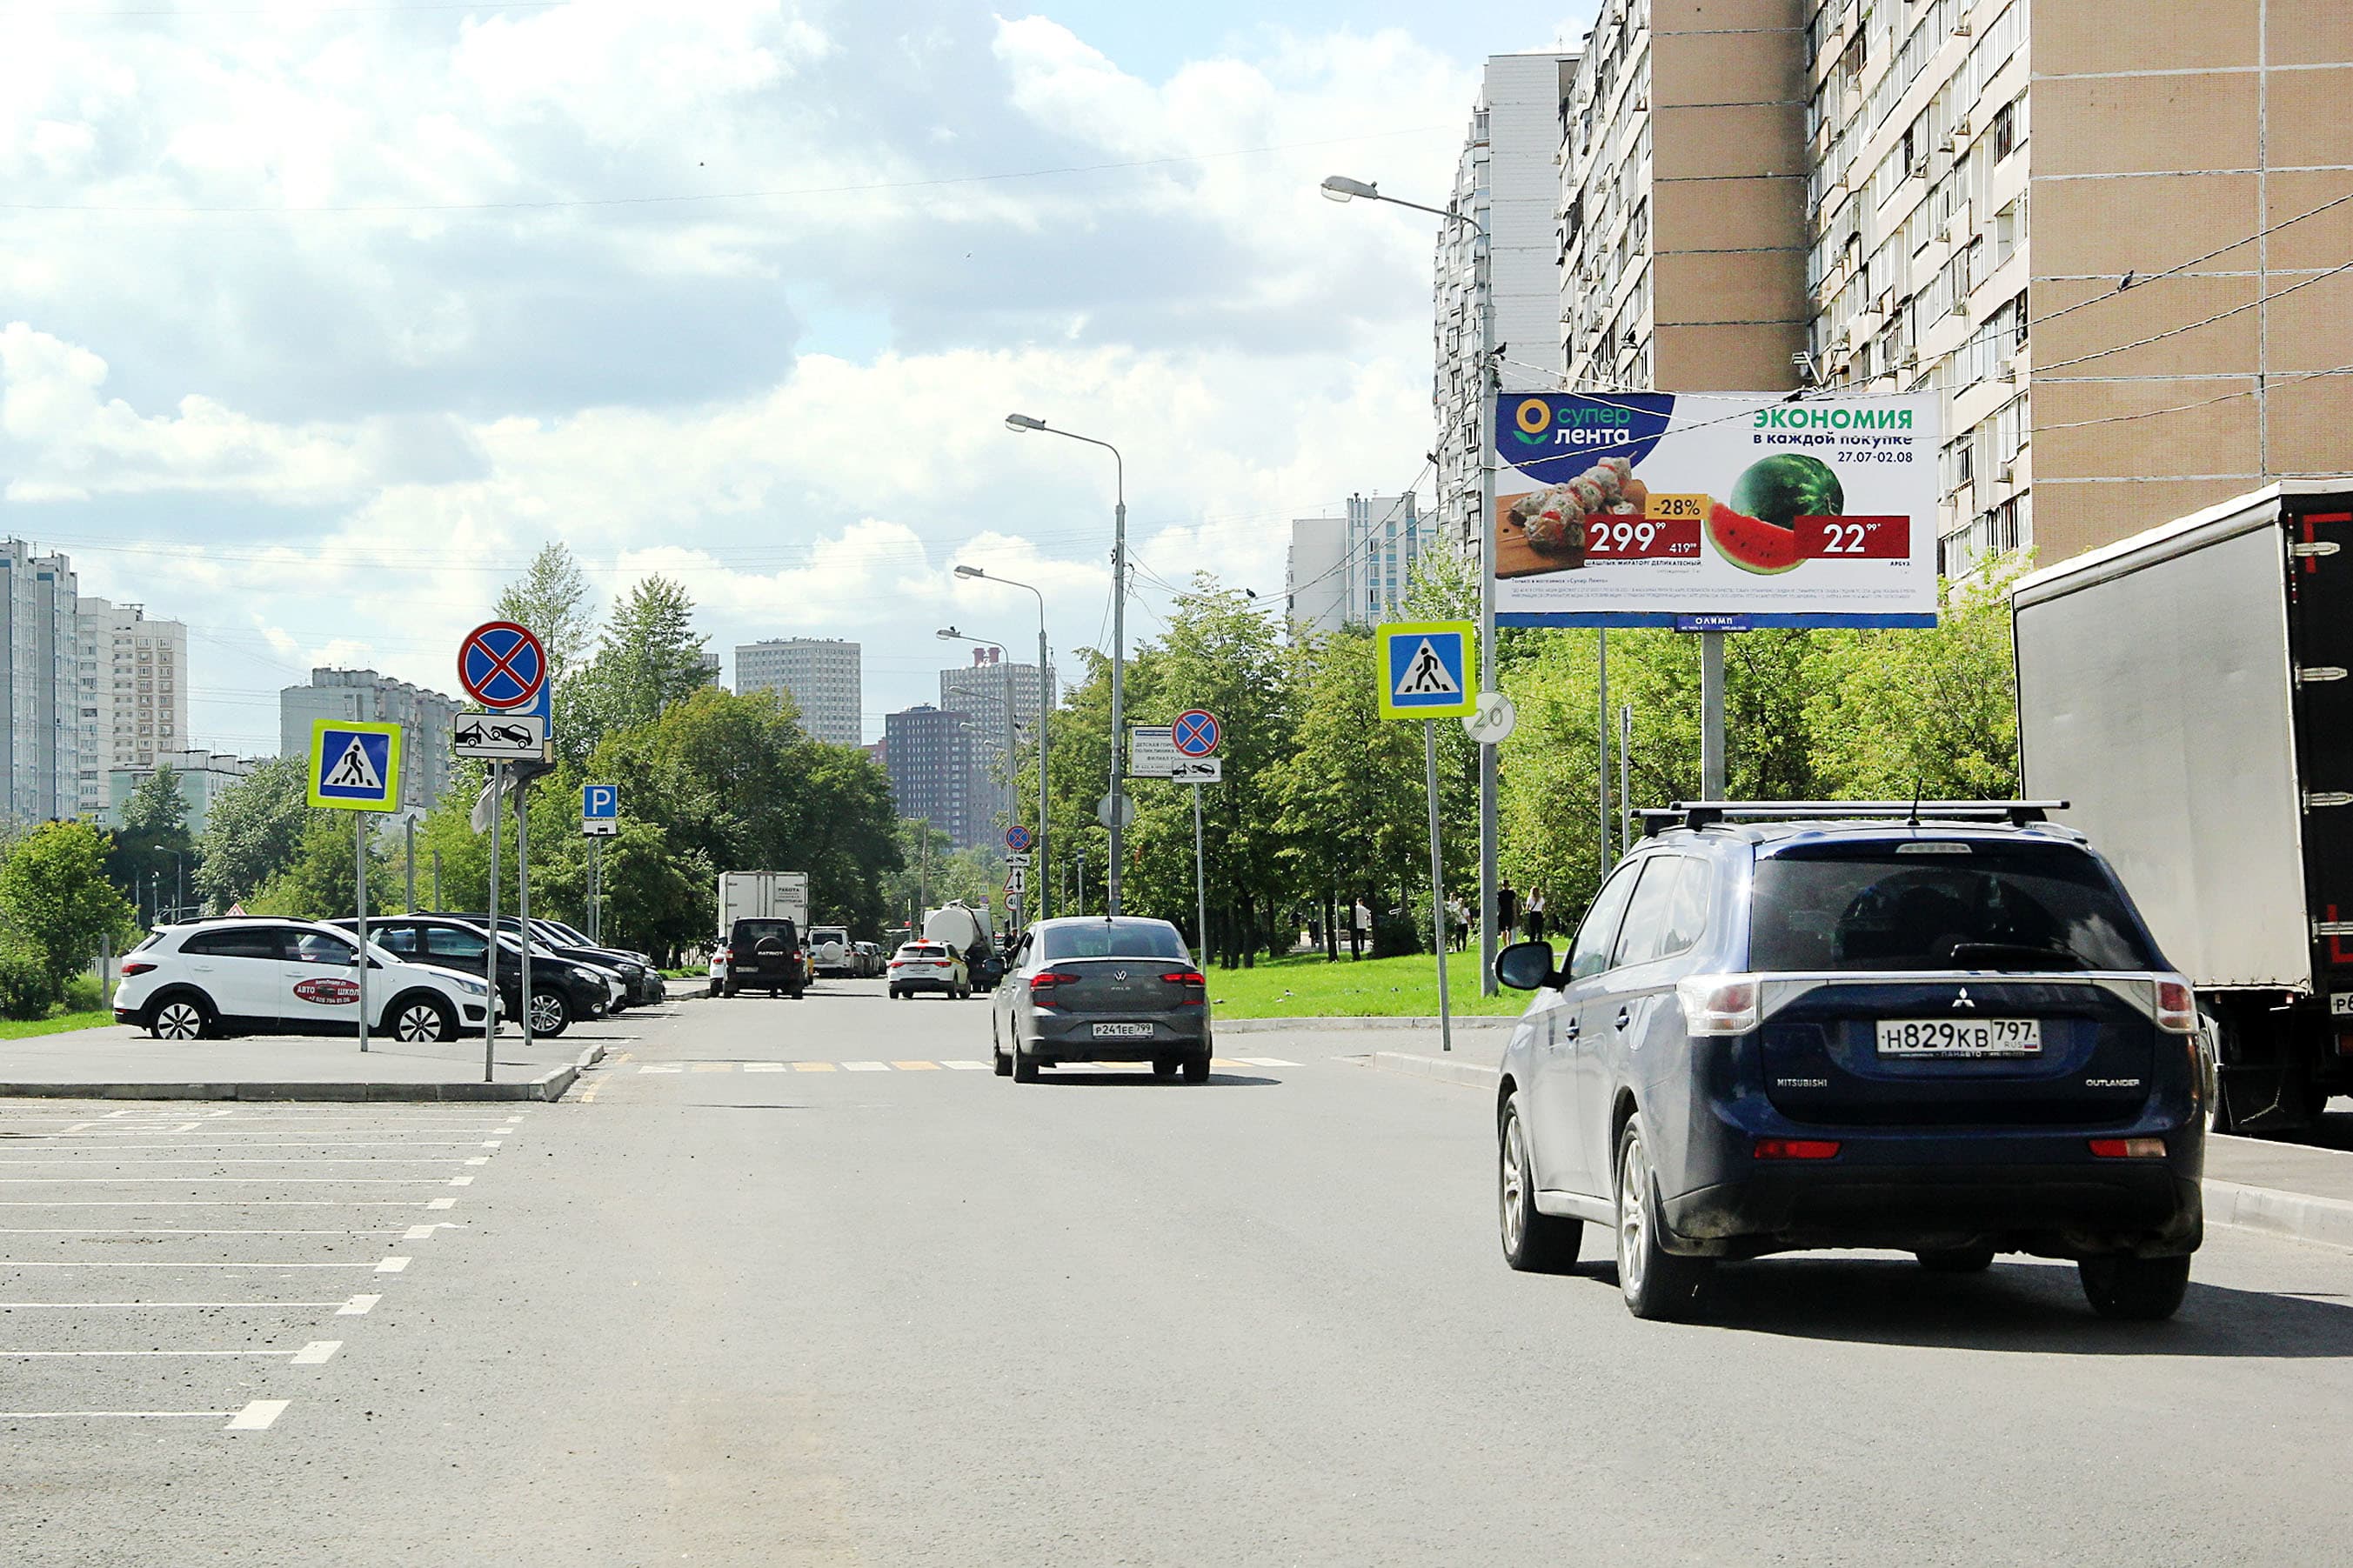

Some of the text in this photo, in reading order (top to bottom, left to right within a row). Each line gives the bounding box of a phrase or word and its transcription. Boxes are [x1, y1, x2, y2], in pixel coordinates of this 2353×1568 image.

[1557, 408, 1631, 427] супер
[1753, 409, 1913, 429] ЭКОНОМИЯ
[1554, 428, 1629, 444] лента
[1754, 435, 1762, 444] в
[1767, 431, 1835, 446] каждой
[1837, 451, 1913, 463] 27.07-02.08
[1653, 499, 1701, 515] -28%
[1695, 617, 1734, 625] ОЛИМП
[592, 789, 611, 814] P
[338, 987, 360, 996] ШКОЛ
[1994, 1021, 2033, 1041] 797
[1776, 1078, 1828, 1087] MITSUBISHI
